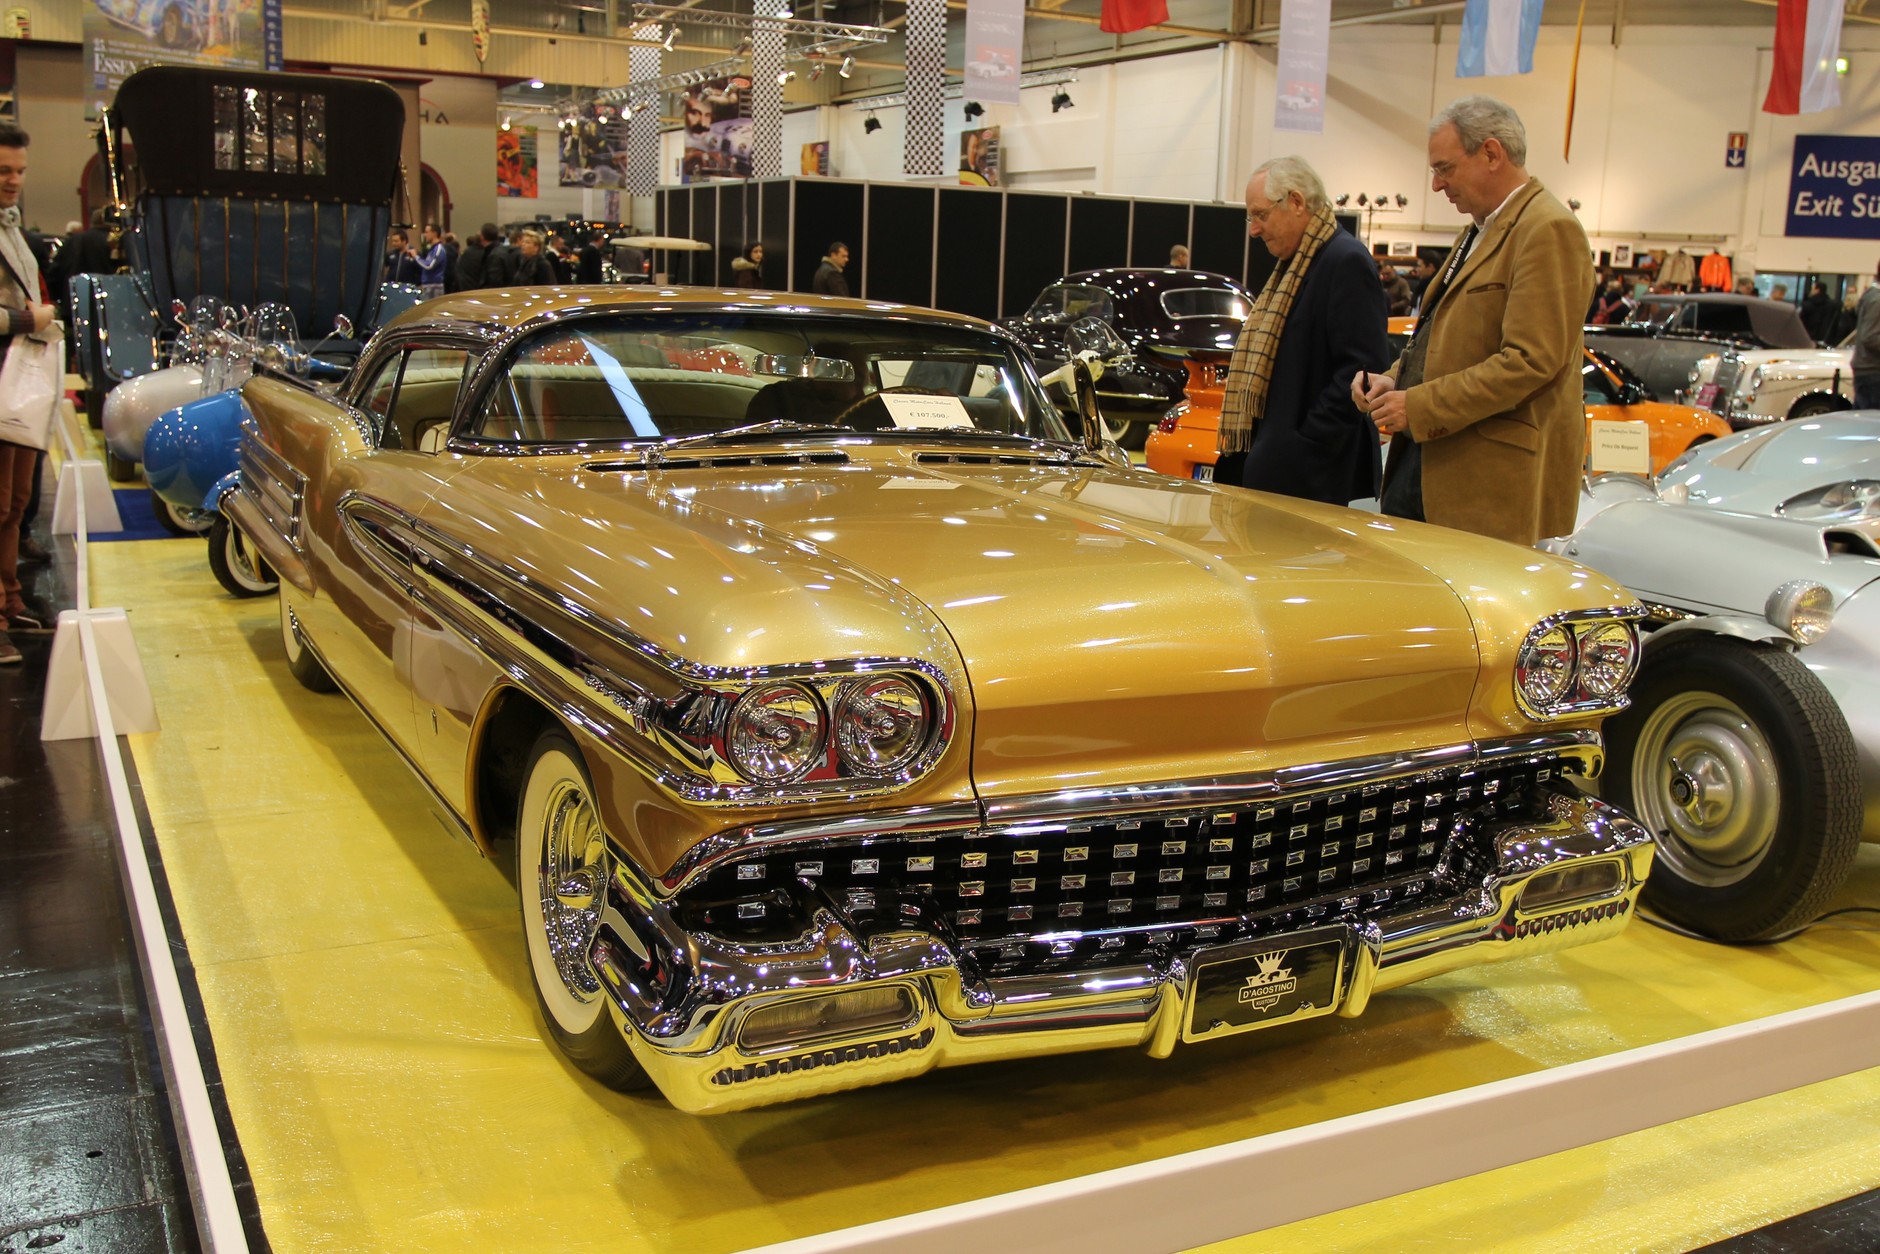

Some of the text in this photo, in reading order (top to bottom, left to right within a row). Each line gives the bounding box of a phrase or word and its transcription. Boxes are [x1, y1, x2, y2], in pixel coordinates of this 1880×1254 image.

[1798, 153, 1880, 187] Ausga
[1794, 191, 1843, 217] Exit
[1450, 248, 1463, 269] MOTOR
[1443, 267, 1454, 285] SHOW
[1242, 981, 1294, 999] D'AGOSTINO
[1255, 997, 1277, 1007] KUSTOMS
